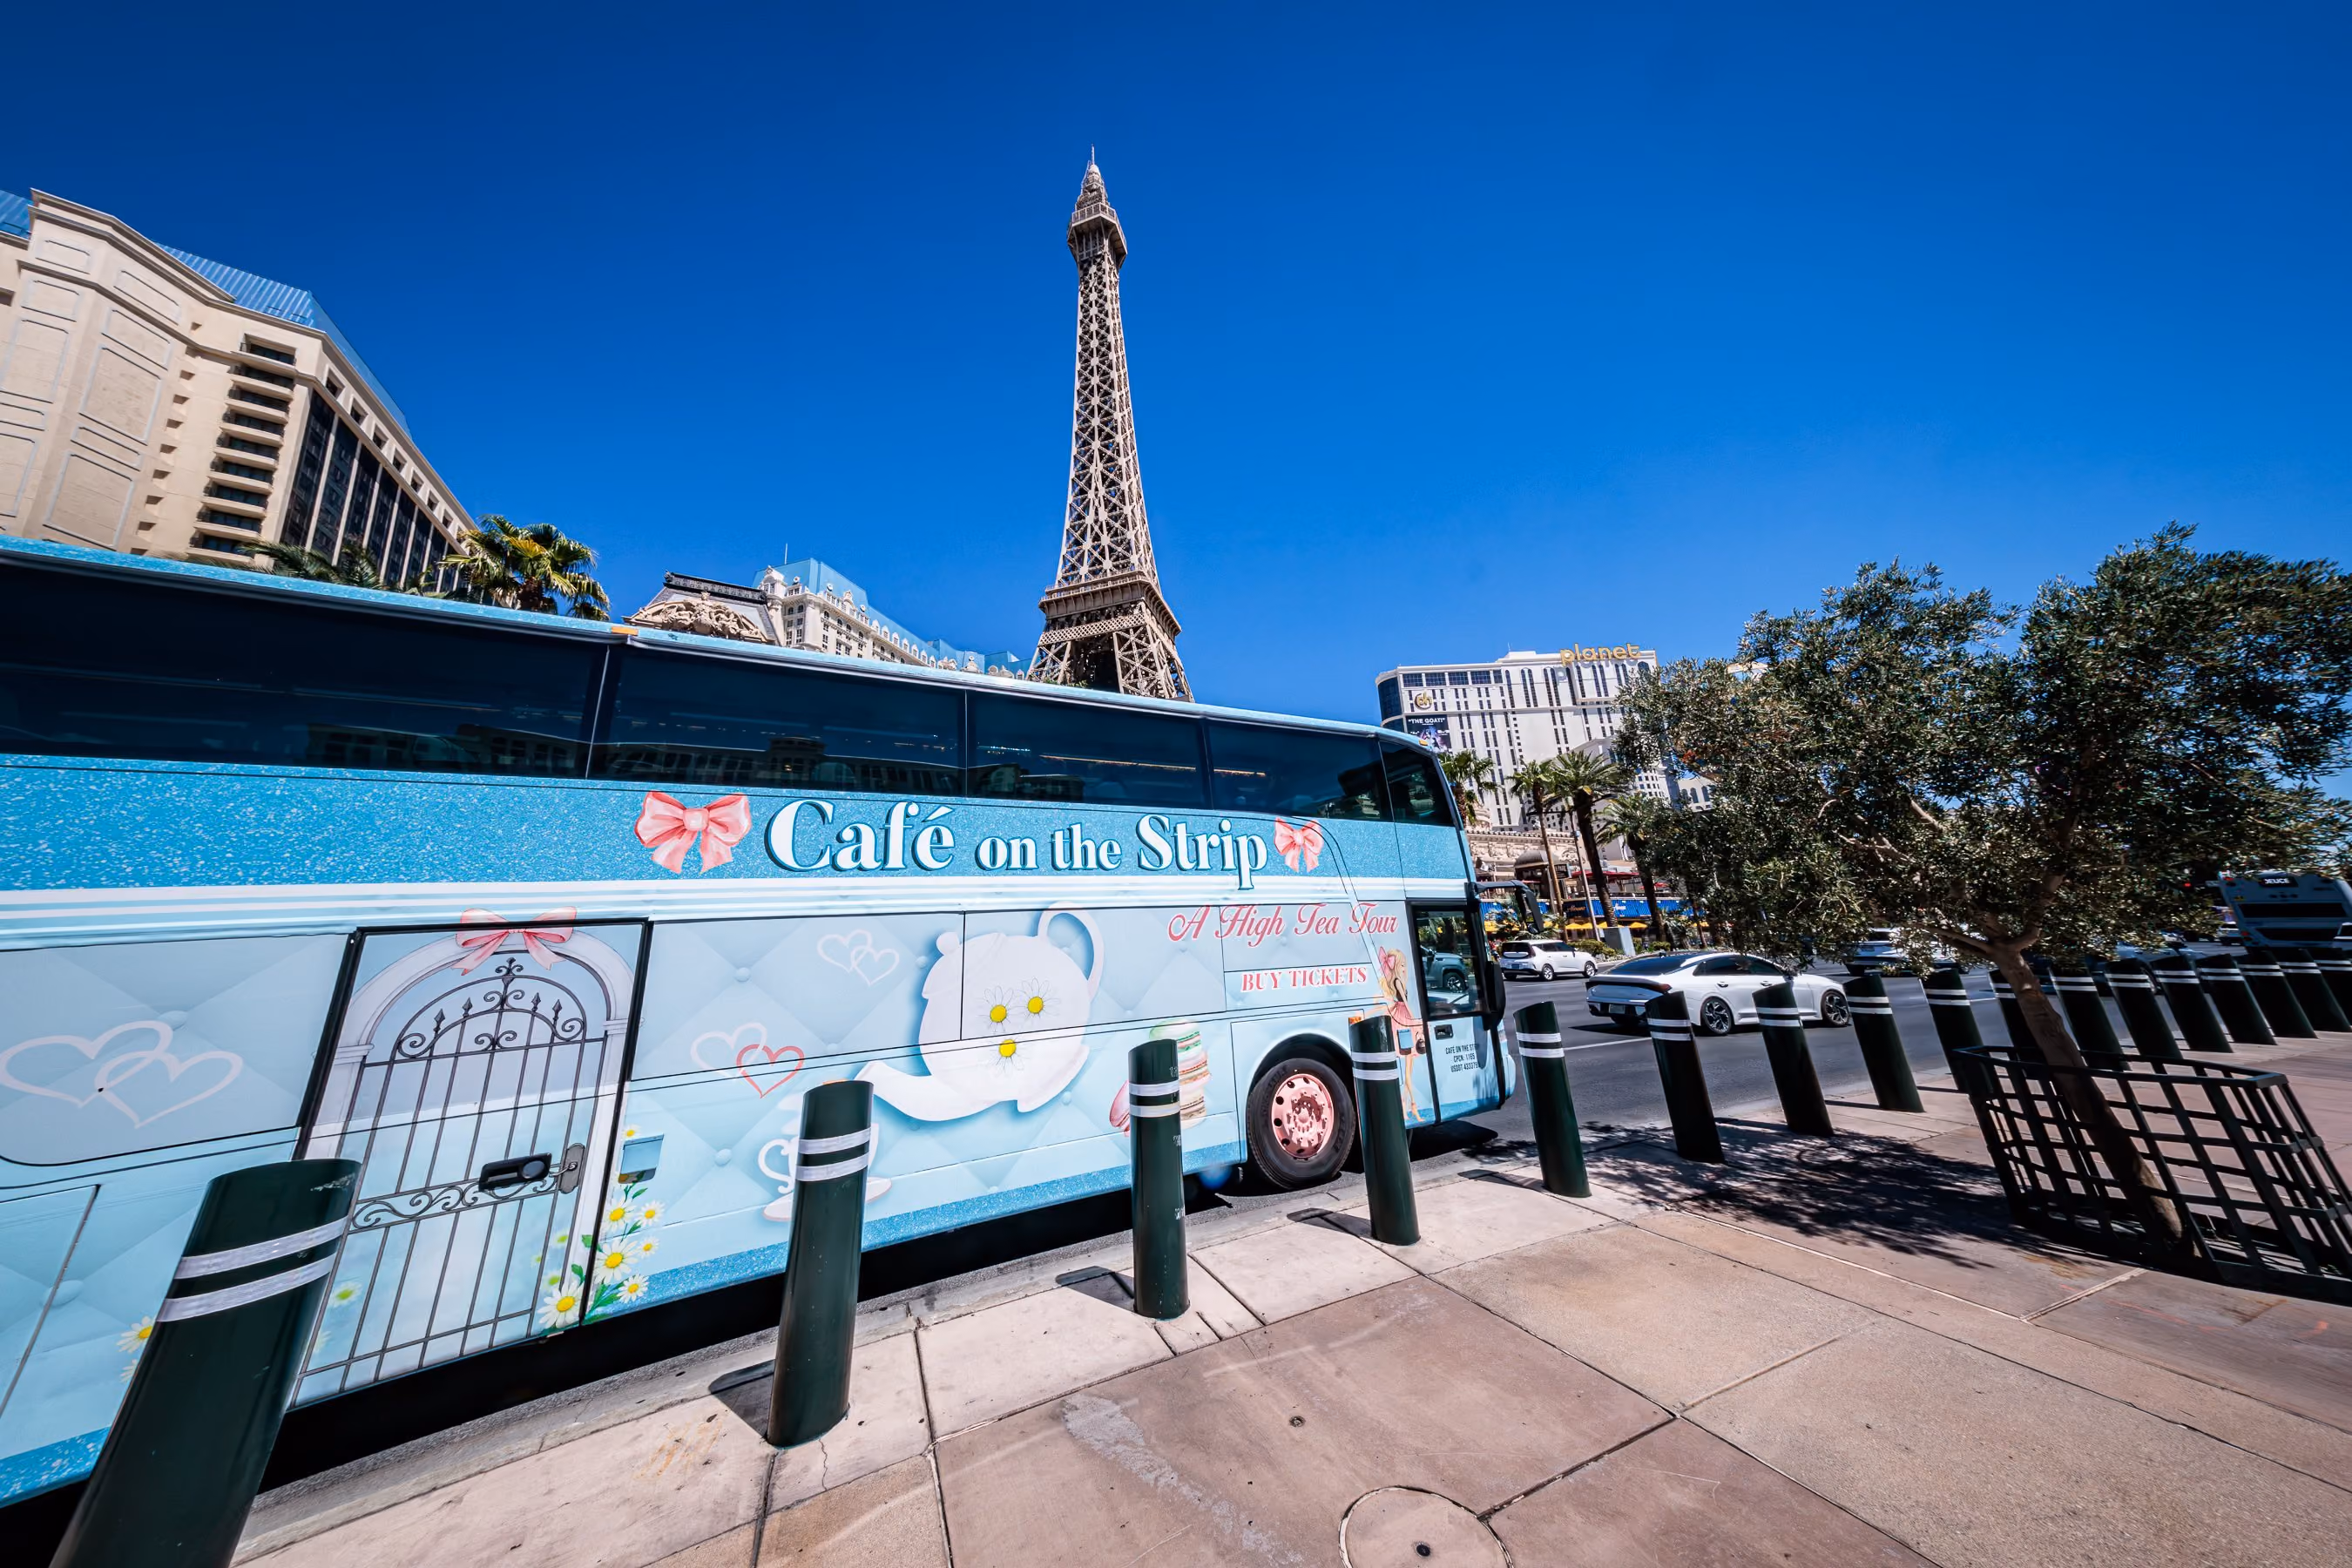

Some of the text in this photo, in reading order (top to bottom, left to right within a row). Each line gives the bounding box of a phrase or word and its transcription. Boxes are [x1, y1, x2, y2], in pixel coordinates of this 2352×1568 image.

[1560, 643, 1641, 666] planet
[764, 800, 1267, 890] Café on the Strip
[1167, 902, 1398, 948] A High Tea Tour
[1240, 967, 1367, 992] BUY TICKETS
